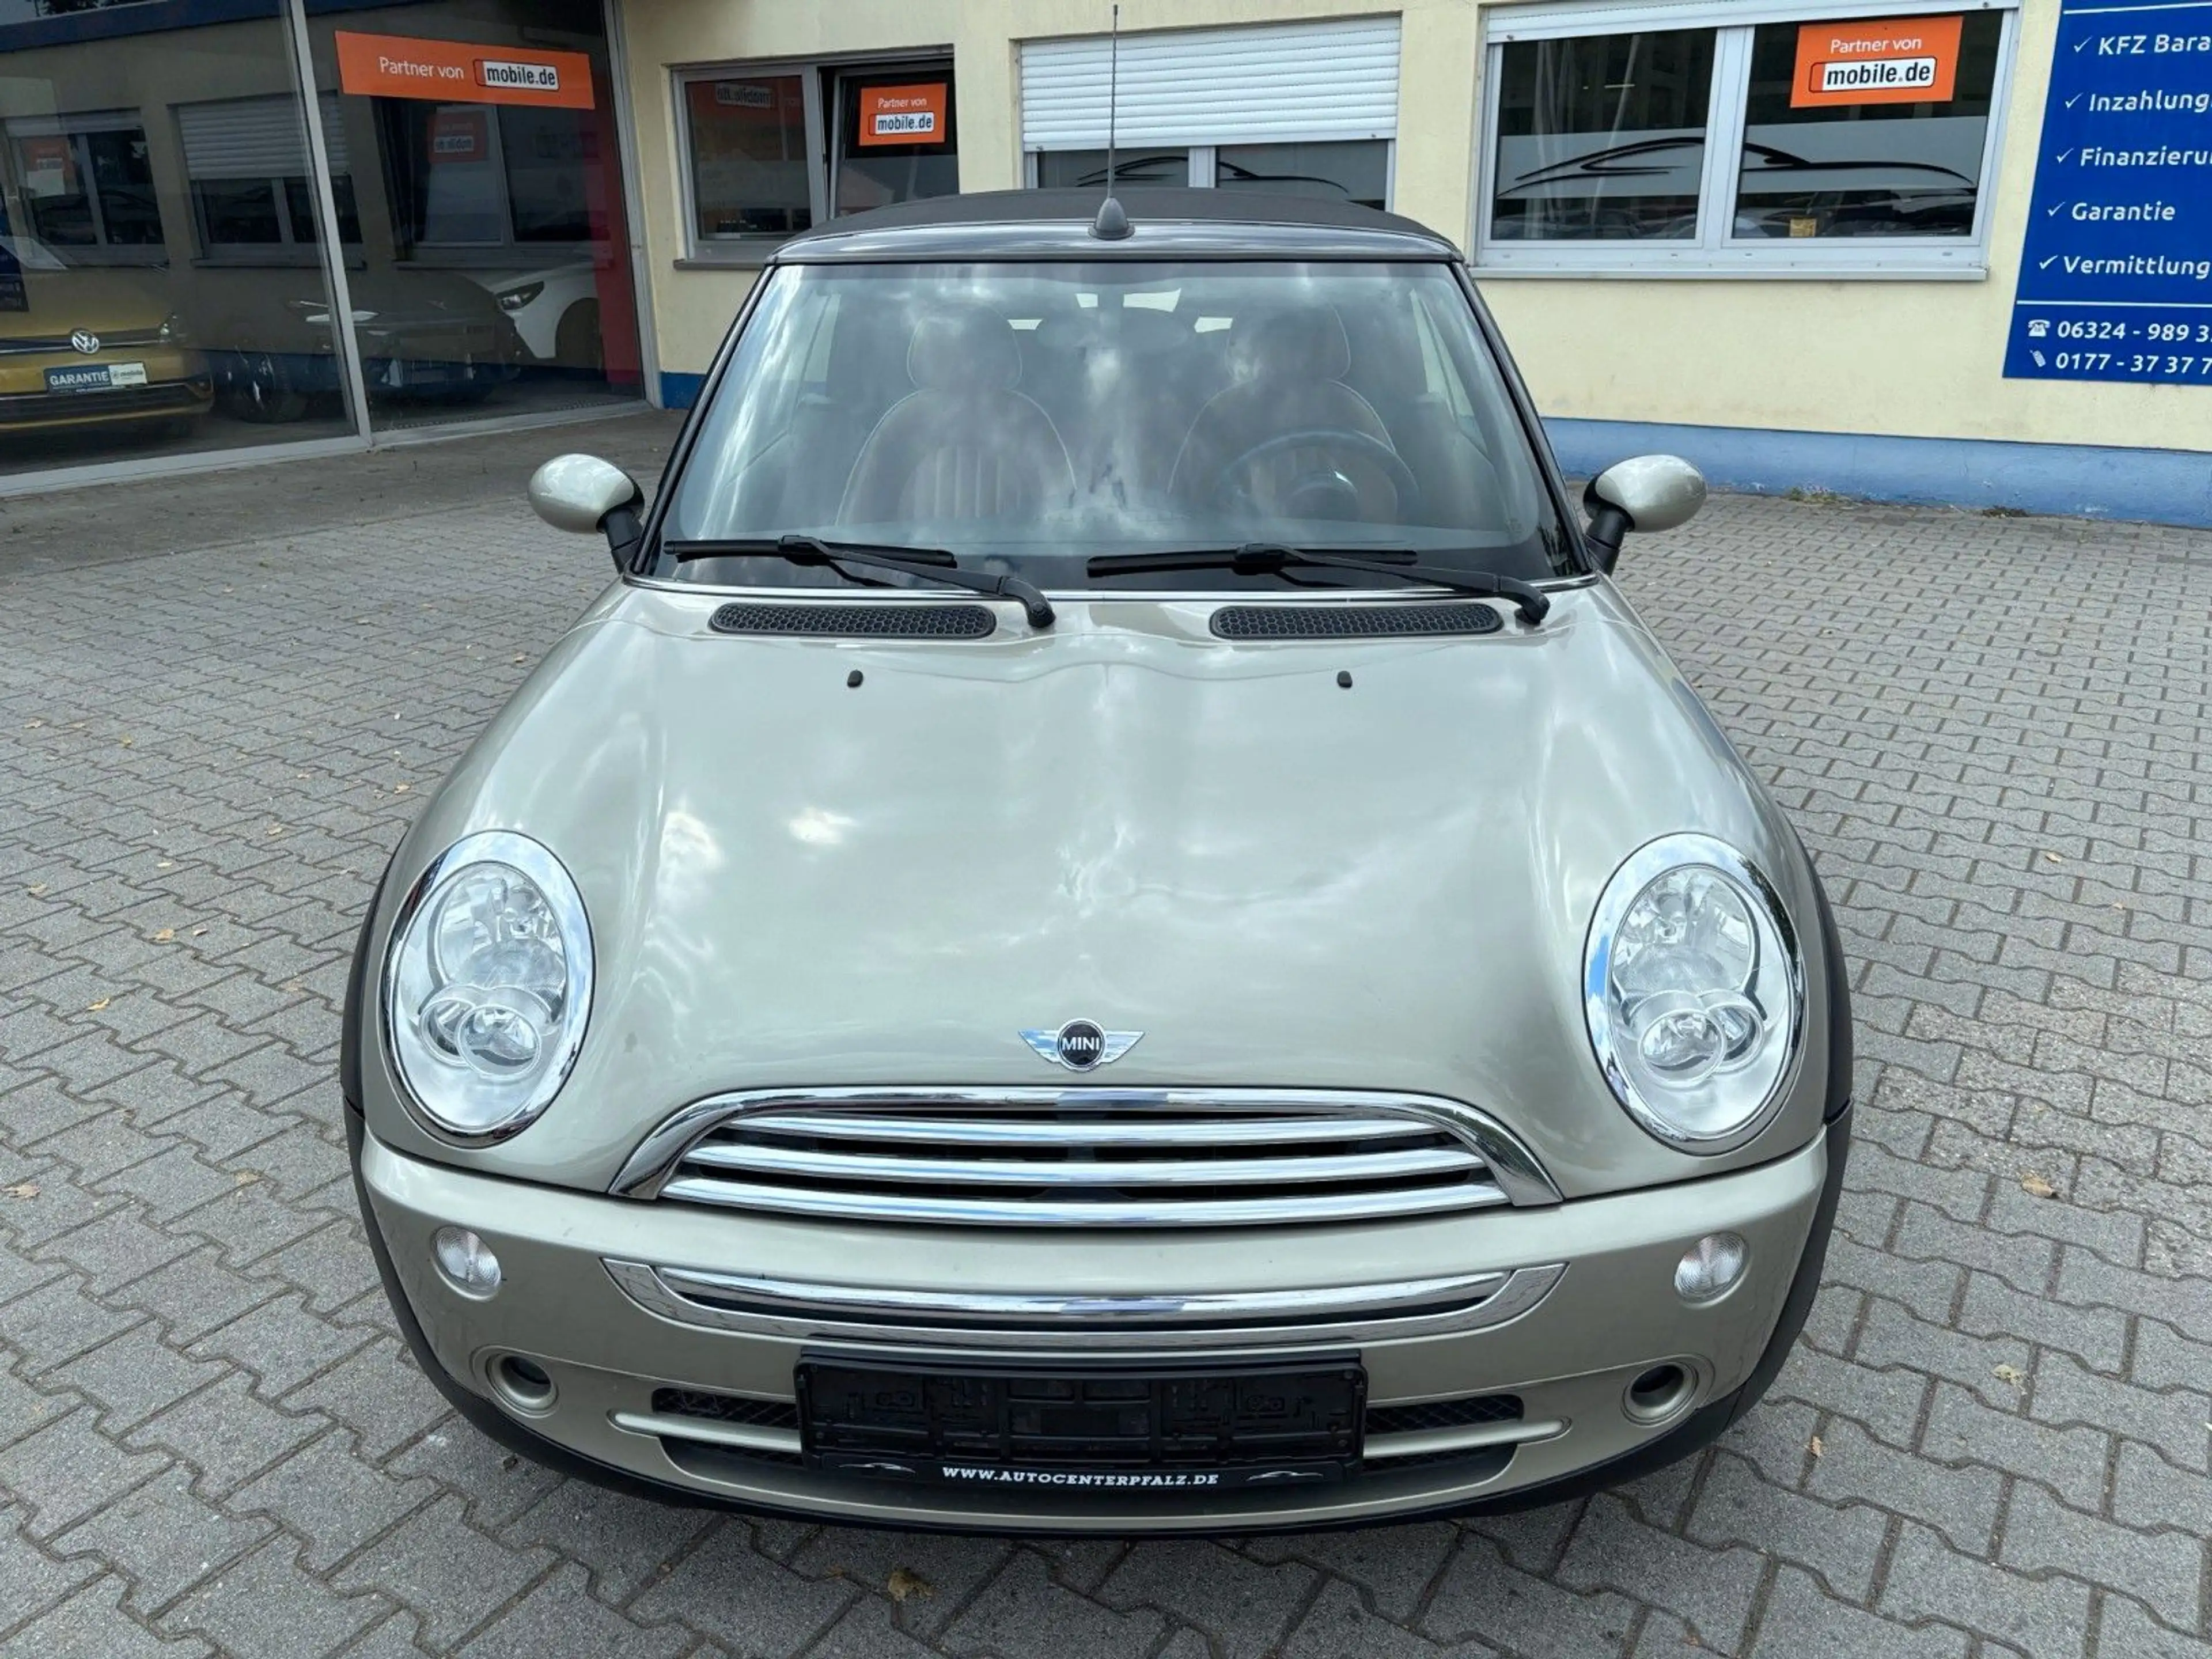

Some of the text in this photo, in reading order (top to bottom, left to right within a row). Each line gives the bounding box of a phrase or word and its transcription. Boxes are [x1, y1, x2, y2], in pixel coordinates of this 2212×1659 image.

[1830, 37, 1922, 54] Partner von
[2098, 33, 2211, 55] KFZ Bara
[378, 56, 556, 86] Partner von mobile.de
[1826, 62, 1930, 85] mobile.de
[877, 97, 927, 108] Partner von
[2089, 89, 2212, 113] Inzahlung
[877, 115, 933, 131] mobile.de
[2080, 145, 2212, 167] Finanzieru
[2071, 200, 2176, 221] Garantie
[2063, 255, 2211, 280] Vermittlung
[2057, 320, 2126, 339] 06324
[2147, 323, 2190, 342] 989
[2195, 324, 2212, 343] 3
[2055, 352, 2111, 370] 0177
[2130, 354, 2159, 372] 37
[2165, 356, 2194, 374] 37
[2201, 357, 2212, 375] 7
[50, 370, 109, 387] GARANTIE
[1062, 1036, 1100, 1051] MINI
[942, 1466, 1219, 1486] WWW.AUTOCENTERPFALZ.DE
